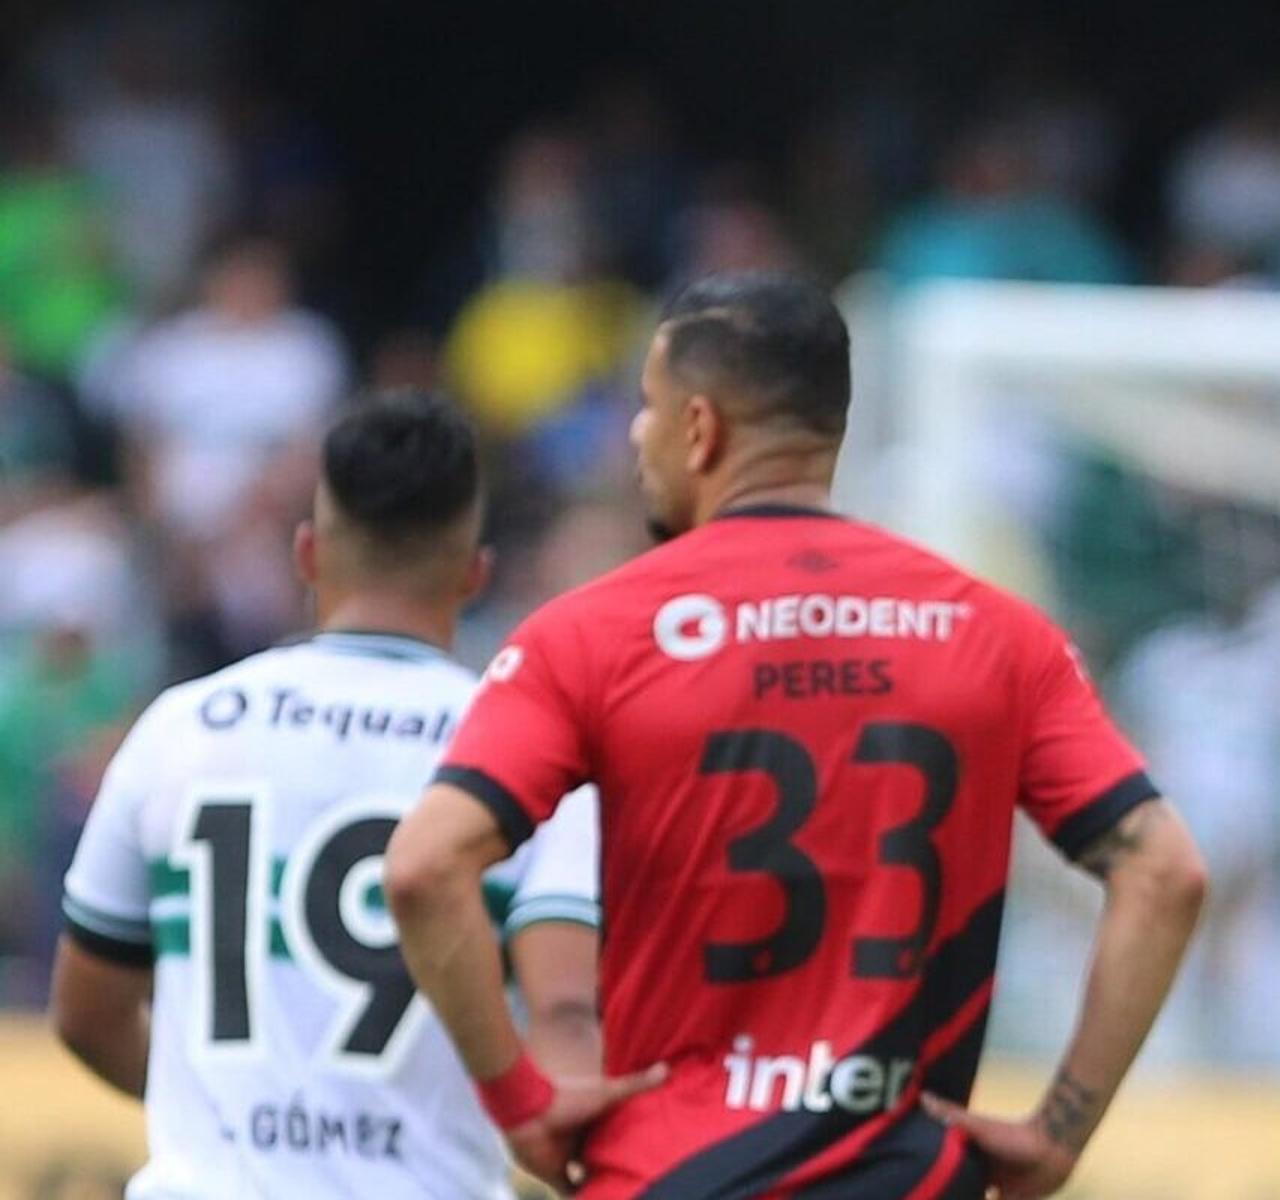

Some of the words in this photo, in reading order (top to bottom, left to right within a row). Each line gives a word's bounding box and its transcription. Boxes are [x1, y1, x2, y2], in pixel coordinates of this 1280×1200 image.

[735, 592, 957, 644] NEODENT
[752, 657, 895, 702] PERES
[269, 686, 457, 745] Tequal
[698, 721, 962, 985] 33
[187, 800, 418, 1057] 19
[723, 1034, 914, 1114] inter
